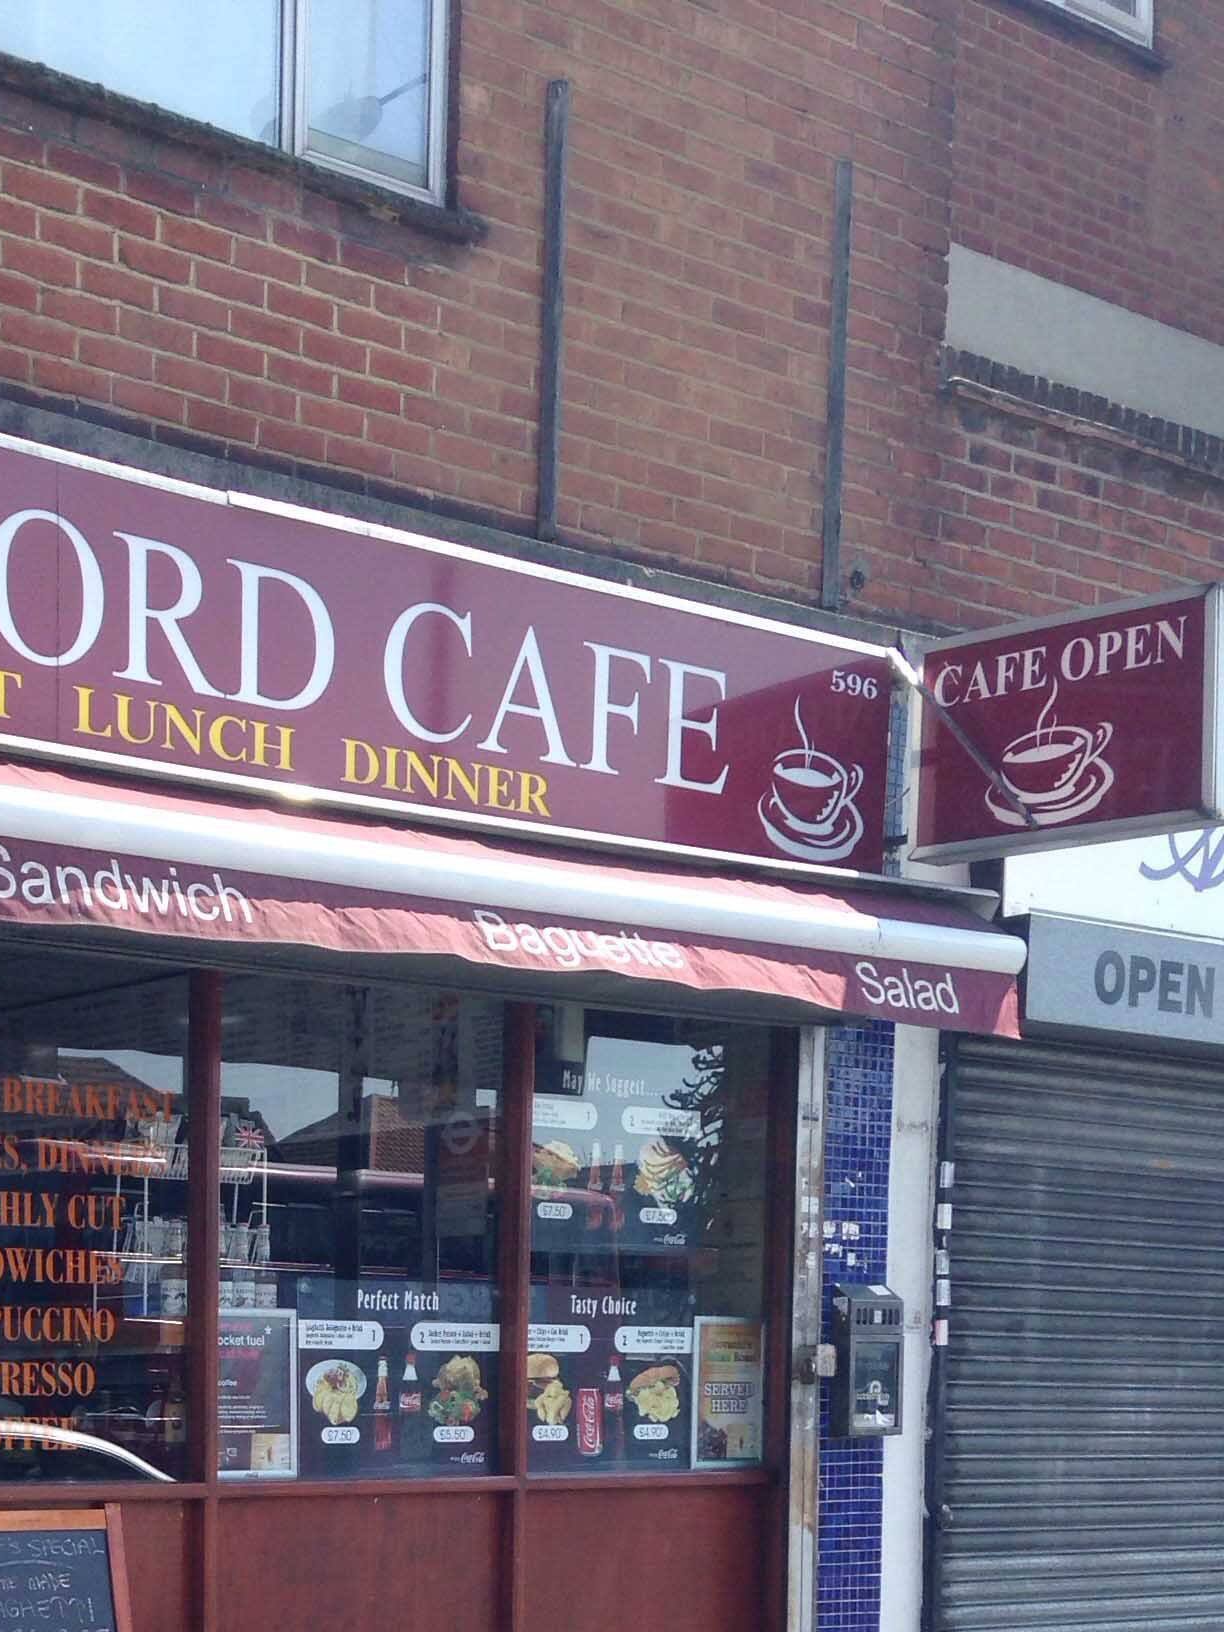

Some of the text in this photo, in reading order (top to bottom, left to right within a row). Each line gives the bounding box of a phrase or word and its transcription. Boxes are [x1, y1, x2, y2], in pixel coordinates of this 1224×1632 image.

[933, 614, 1188, 710] CAFE OPEN
[382, 602, 730, 796] CAFE
[829, 668, 880, 701] 596
[72, 685, 297, 772] LUNCH
[341, 737, 552, 818] DINNER
[473, 909, 686, 976] Baguette
[855, 959, 961, 1016] Salad
[1093, 949, 1217, 1019] OPEN
[3, 1075, 174, 1121] BREAKFAST
[562, 1069, 583, 1096] May
[67, 1194, 127, 1231] CUT
[357, 1288, 440, 1312] Perfect Match
[570, 1294, 638, 1318] Tasty Choice
[218, 1335, 245, 1347] ocket
[711, 1399, 747, 1412] HERE
[27, 1536, 106, 1559] SPECIAL
